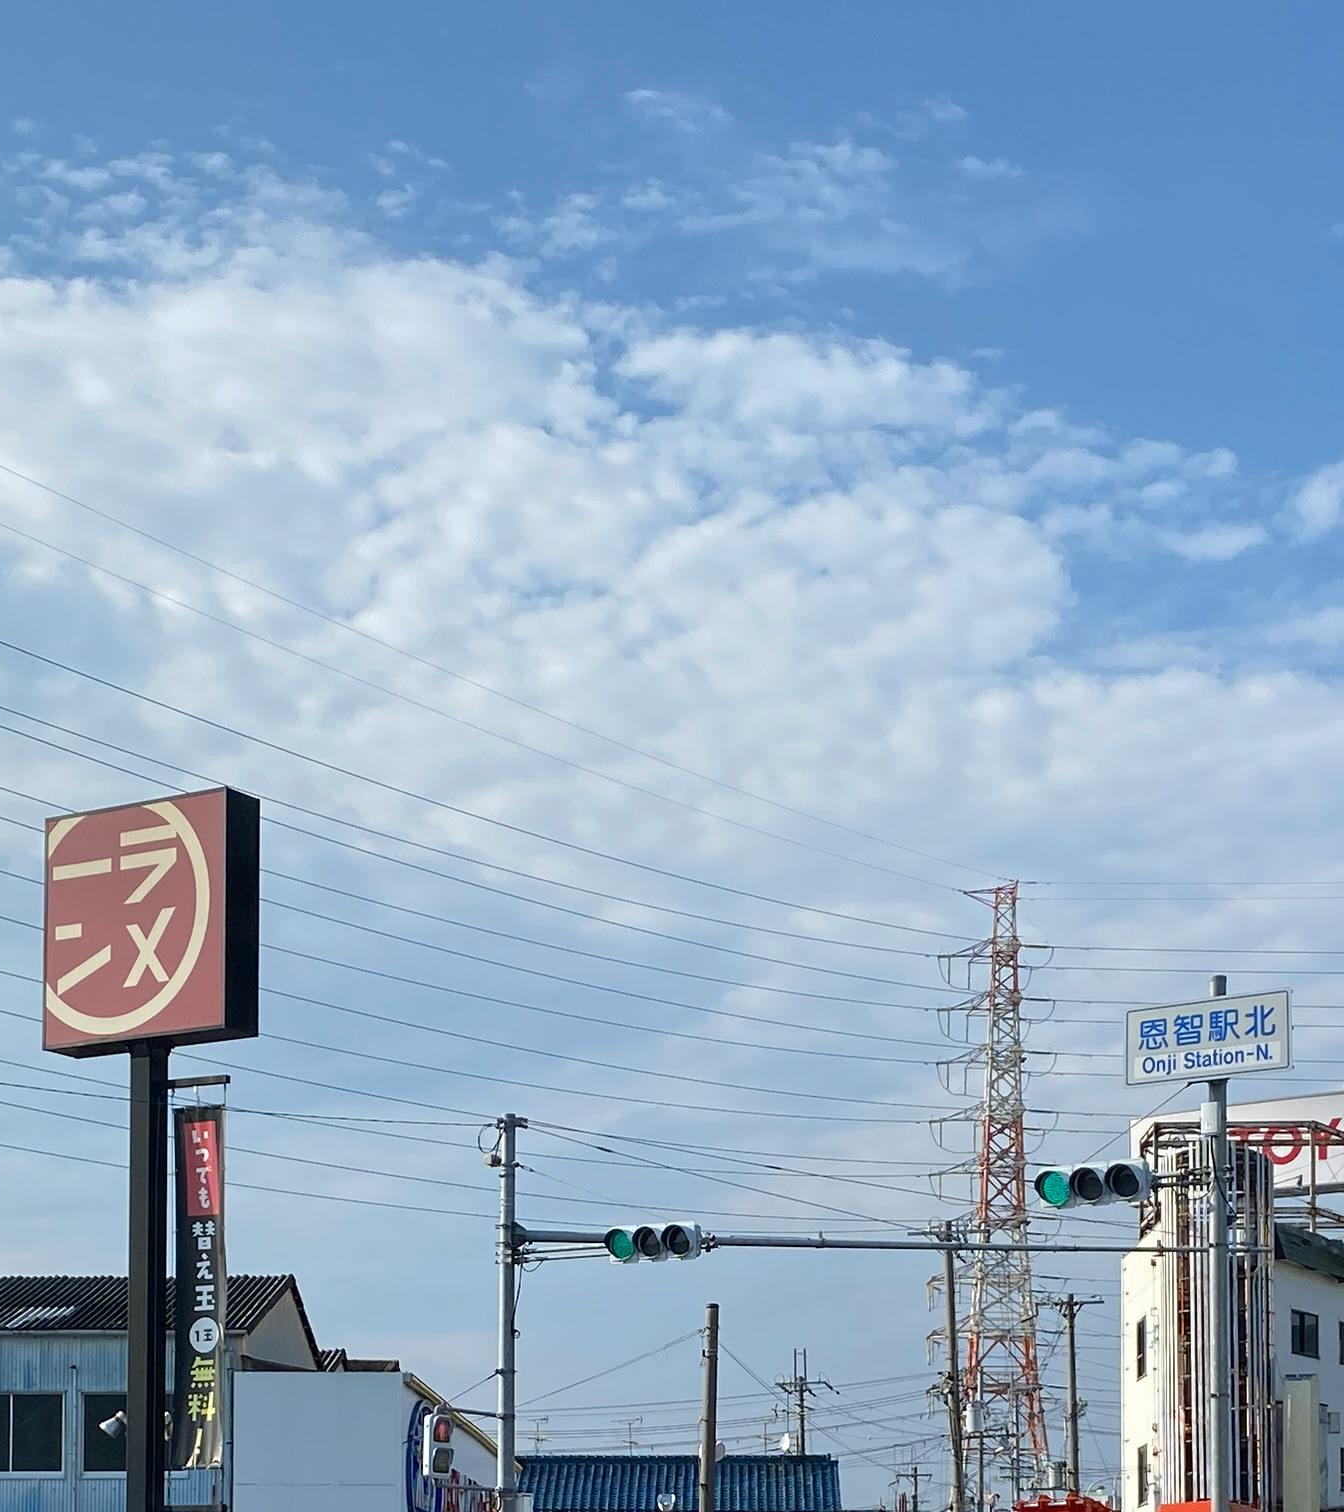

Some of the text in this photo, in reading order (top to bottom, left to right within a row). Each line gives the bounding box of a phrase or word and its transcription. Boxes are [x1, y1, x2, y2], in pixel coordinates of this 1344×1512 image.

[1138, 1004, 1276, 1051] 恩智駅北
[1142, 1043, 1273, 1075] Onji Station-N.
[191, 1130, 212, 1209] いつでも
[191, 1221, 216, 1312] 替え玉
